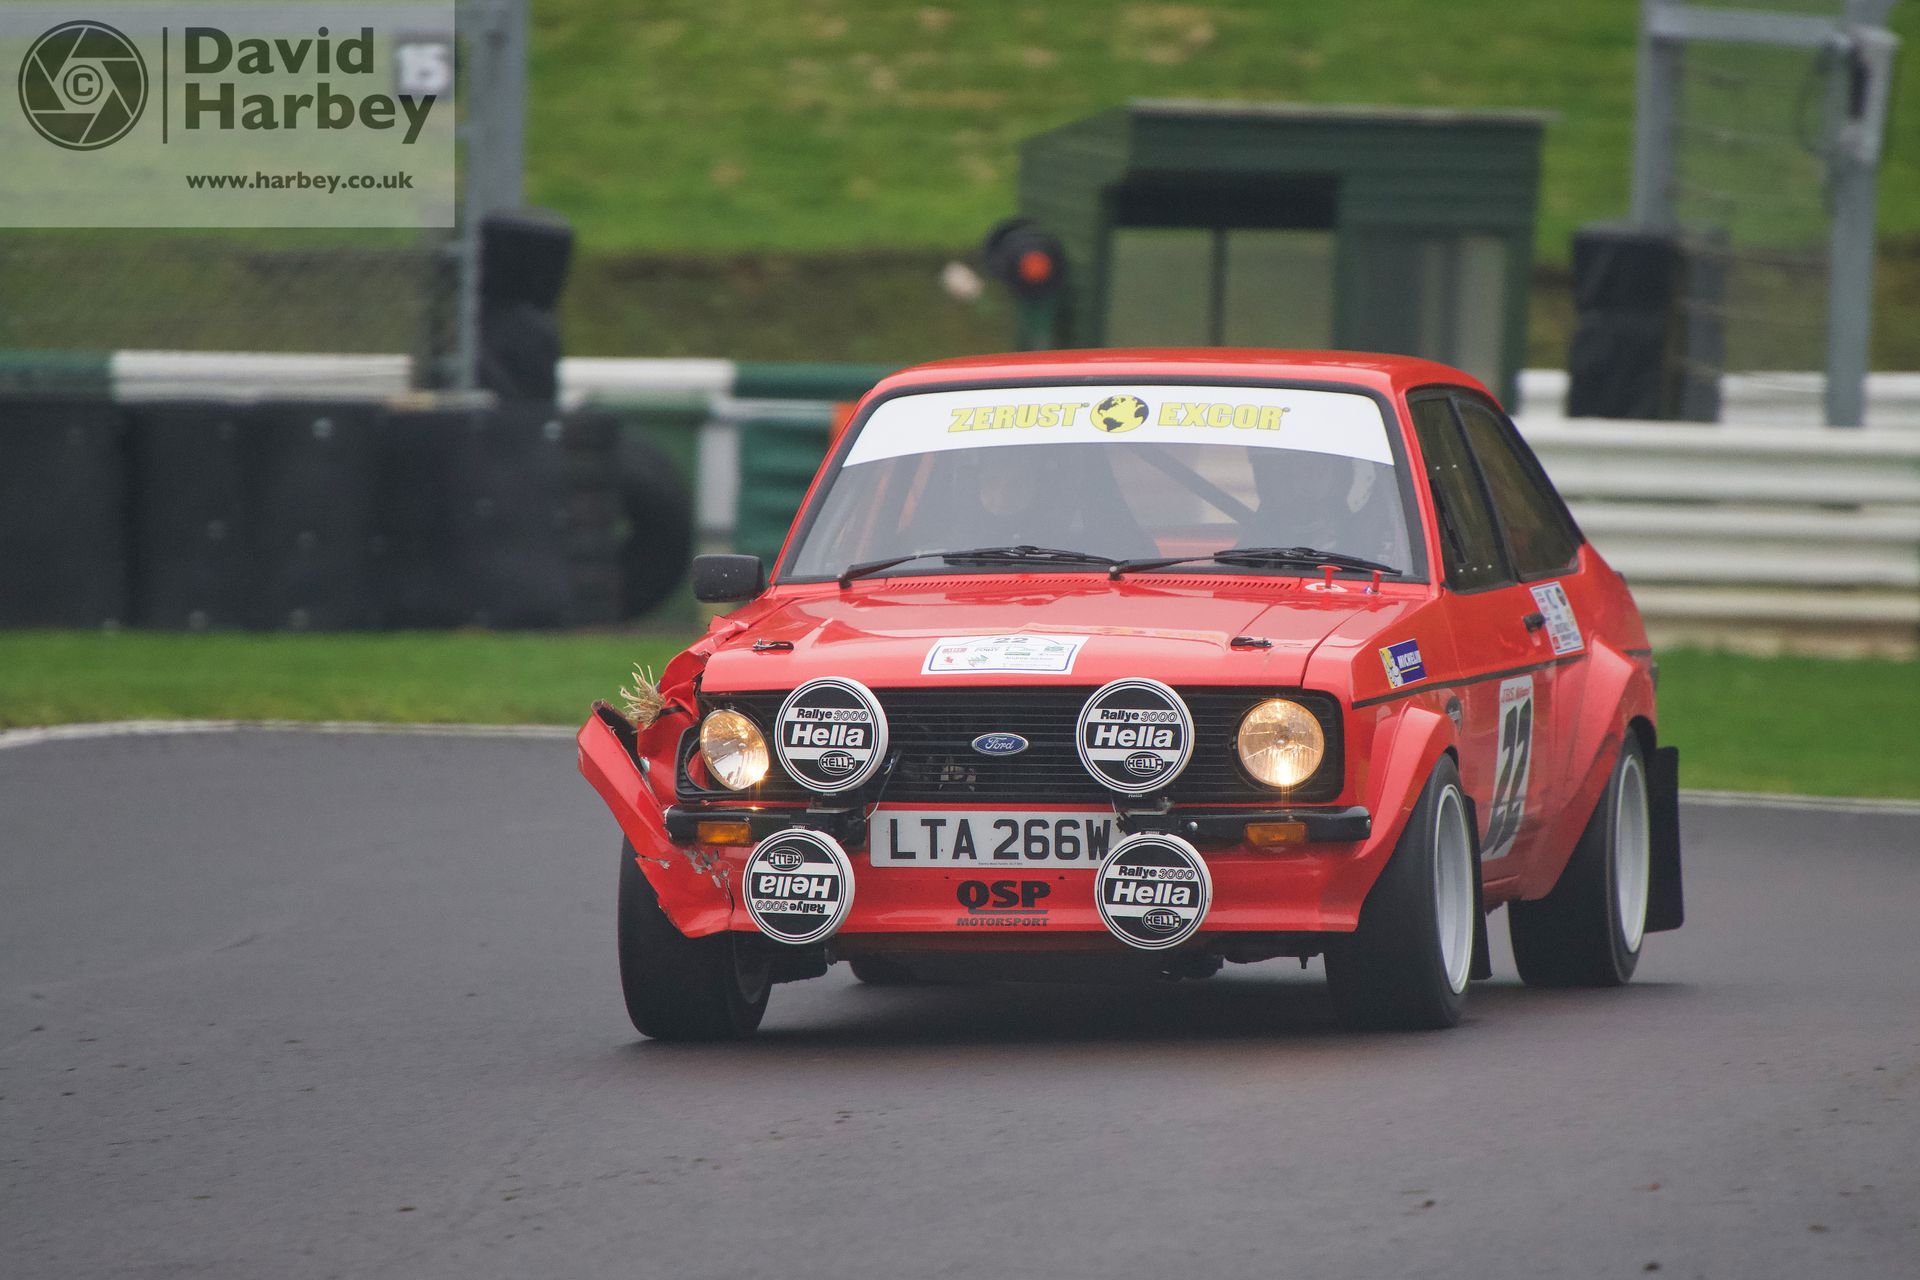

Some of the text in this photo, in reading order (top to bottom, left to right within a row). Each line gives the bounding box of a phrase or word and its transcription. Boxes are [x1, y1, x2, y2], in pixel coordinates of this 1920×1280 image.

[797, 709, 869, 721] Rallye 3000
[1101, 710, 1177, 722] Rallye 3000
[791, 723, 865, 746] Hella
[1094, 725, 1174, 748] Hella
[985, 736, 1014, 749] Ford
[821, 756, 855, 768] HELLA
[1128, 757, 1163, 769] HELLA
[890, 819, 1111, 860] LTA 266W
[769, 853, 800, 864] HELLA
[1118, 866, 1195, 880] Rallye 3000
[759, 875, 831, 898] Hella
[1112, 881, 1192, 905] Hella
[957, 880, 1051, 908] QSP
[755, 900, 825, 913] Rallye 3000
[957, 918, 1049, 927] MOTORSPORT
[1145, 914, 1181, 927] HELLA
